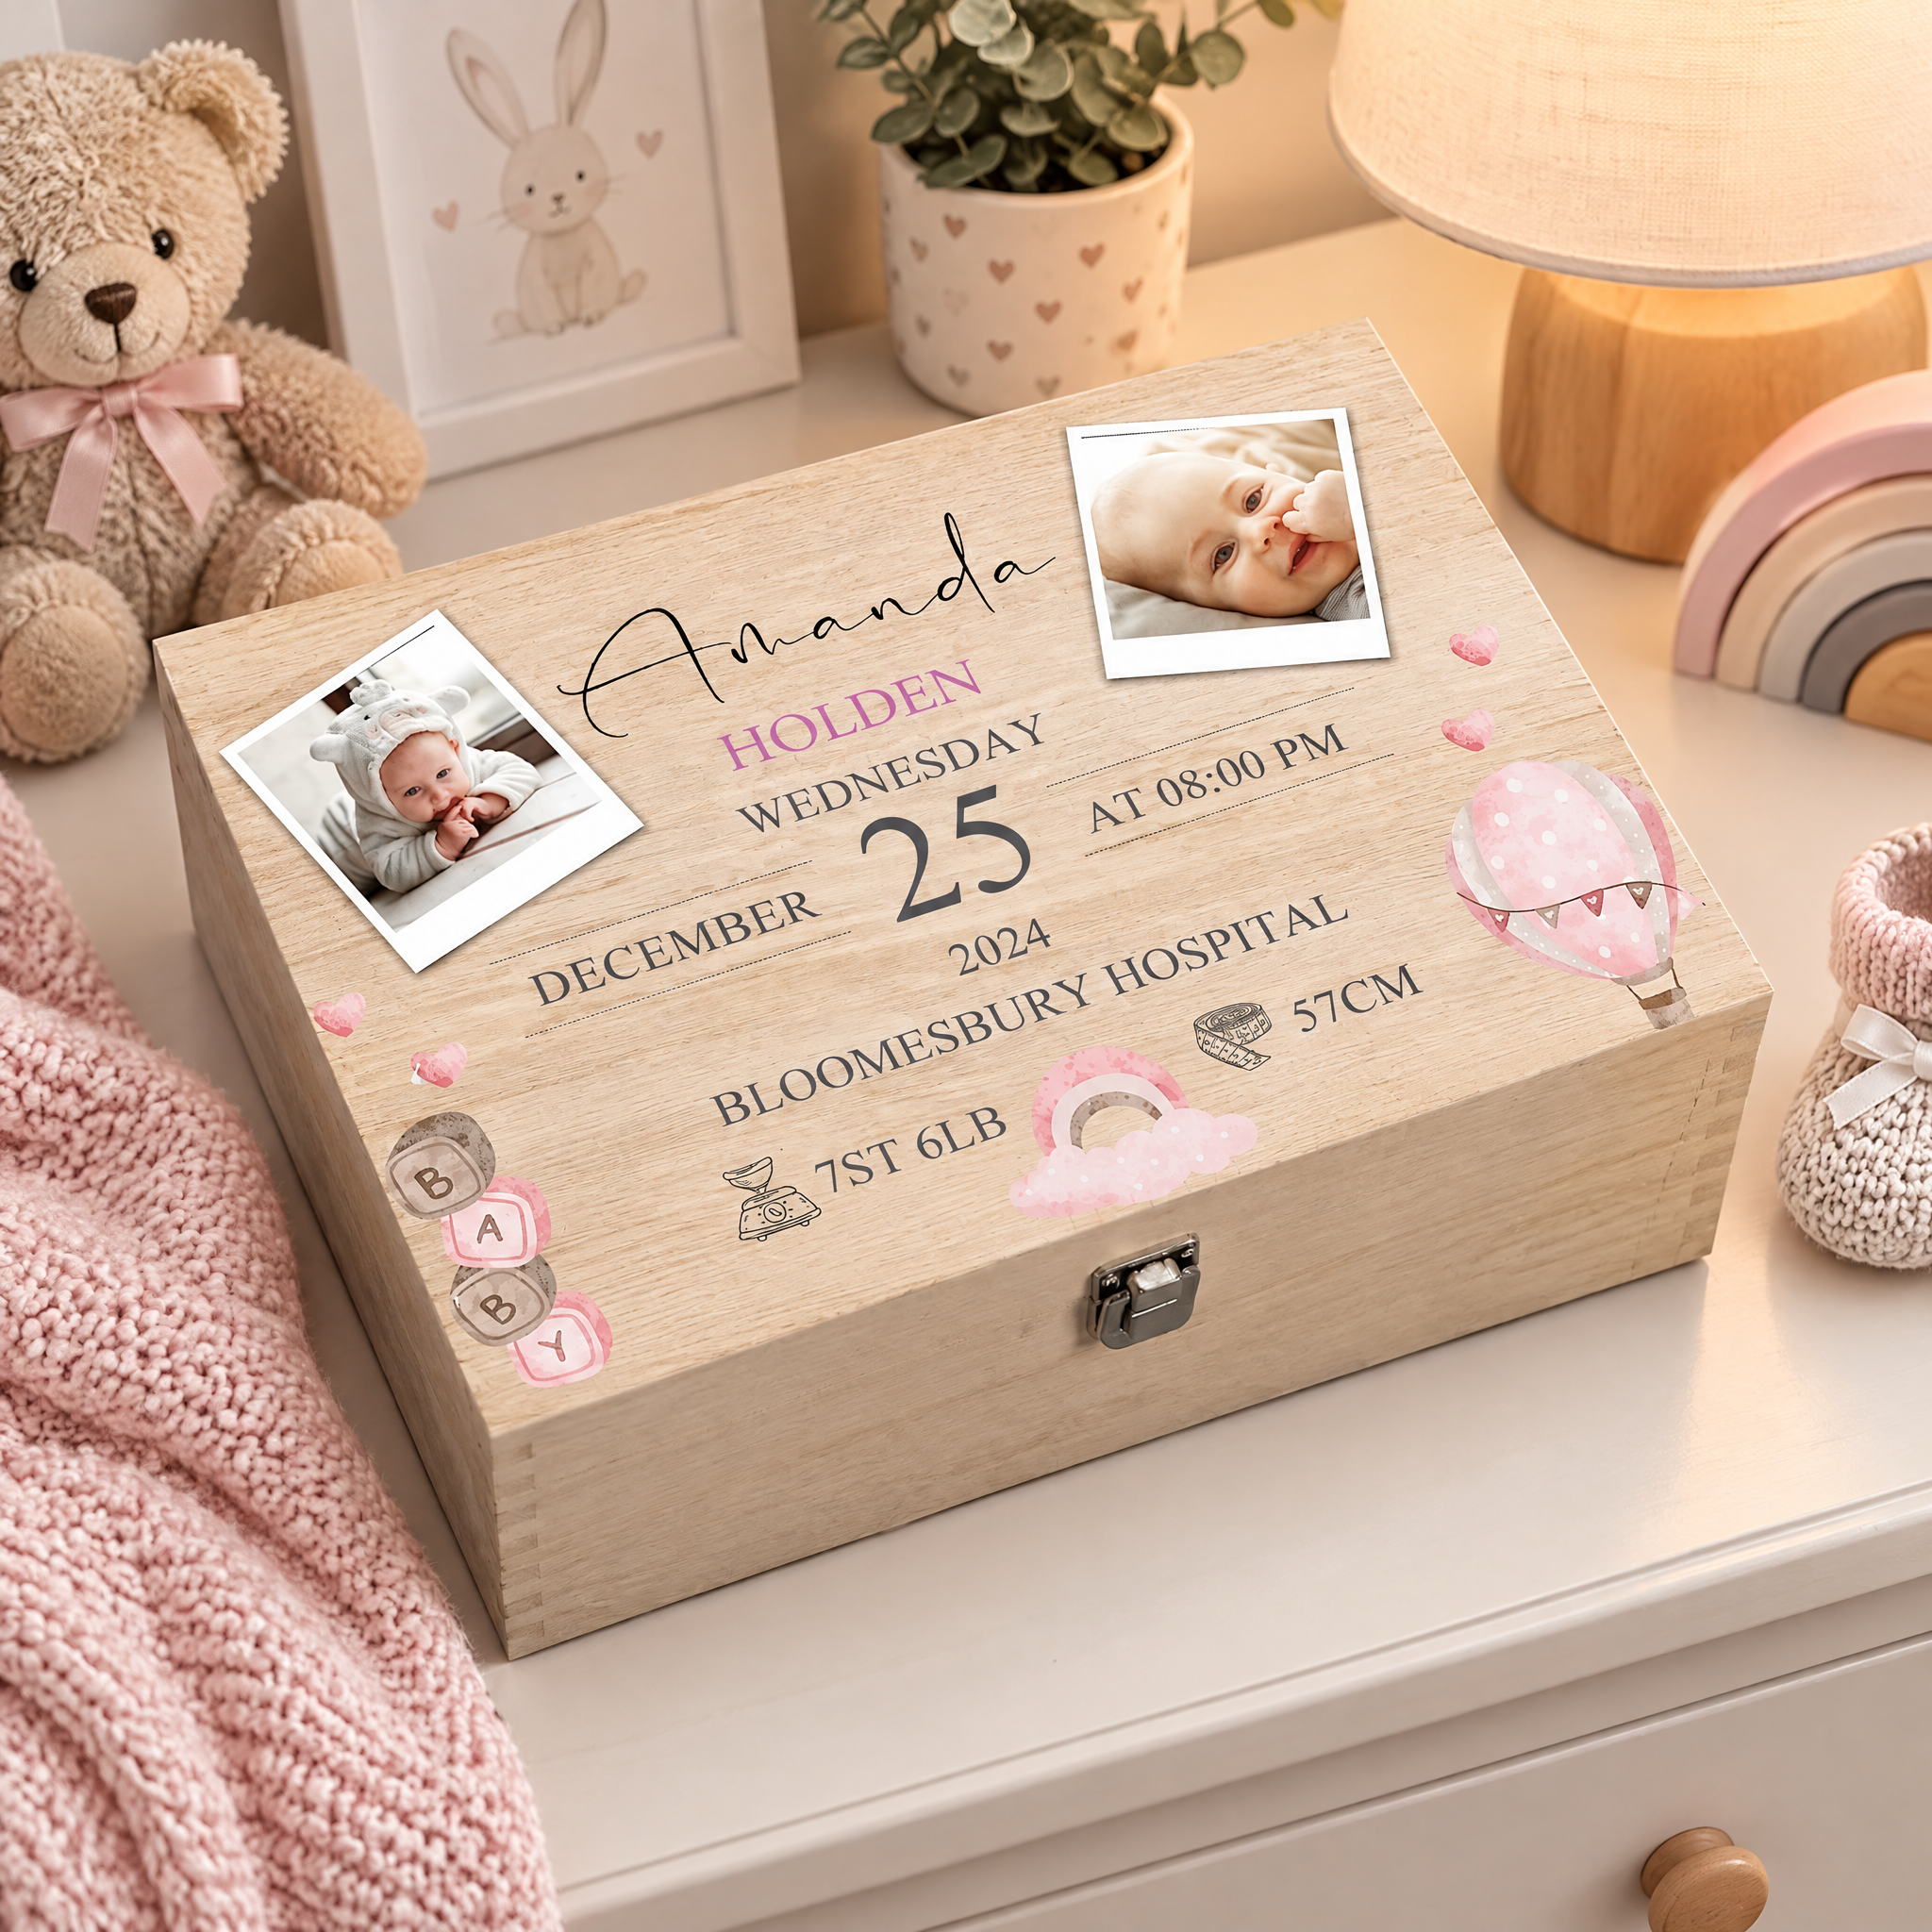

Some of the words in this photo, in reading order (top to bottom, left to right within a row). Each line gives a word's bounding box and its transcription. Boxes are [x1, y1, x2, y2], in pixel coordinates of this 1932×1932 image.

[556, 511, 1057, 739] Amanda
[718, 659, 982, 772] HOLDEN
[736, 713, 1045, 833] WEDNESDAY
[1090, 788, 1146, 834] AT
[1157, 750, 1265, 807] 08:00
[1271, 724, 1349, 771] PM
[860, 785, 1031, 923] 25
[527, 891, 823, 1007] DECEMBER
[948, 918, 1051, 976] 2024
[1293, 963, 1424, 1033] 57CM
[709, 973, 1091, 1127] BLOOMESBURY
[1101, 894, 1349, 996] HOSPITAL
[814, 1138, 902, 1193] 7ST
[916, 1107, 1007, 1159] 6LB
